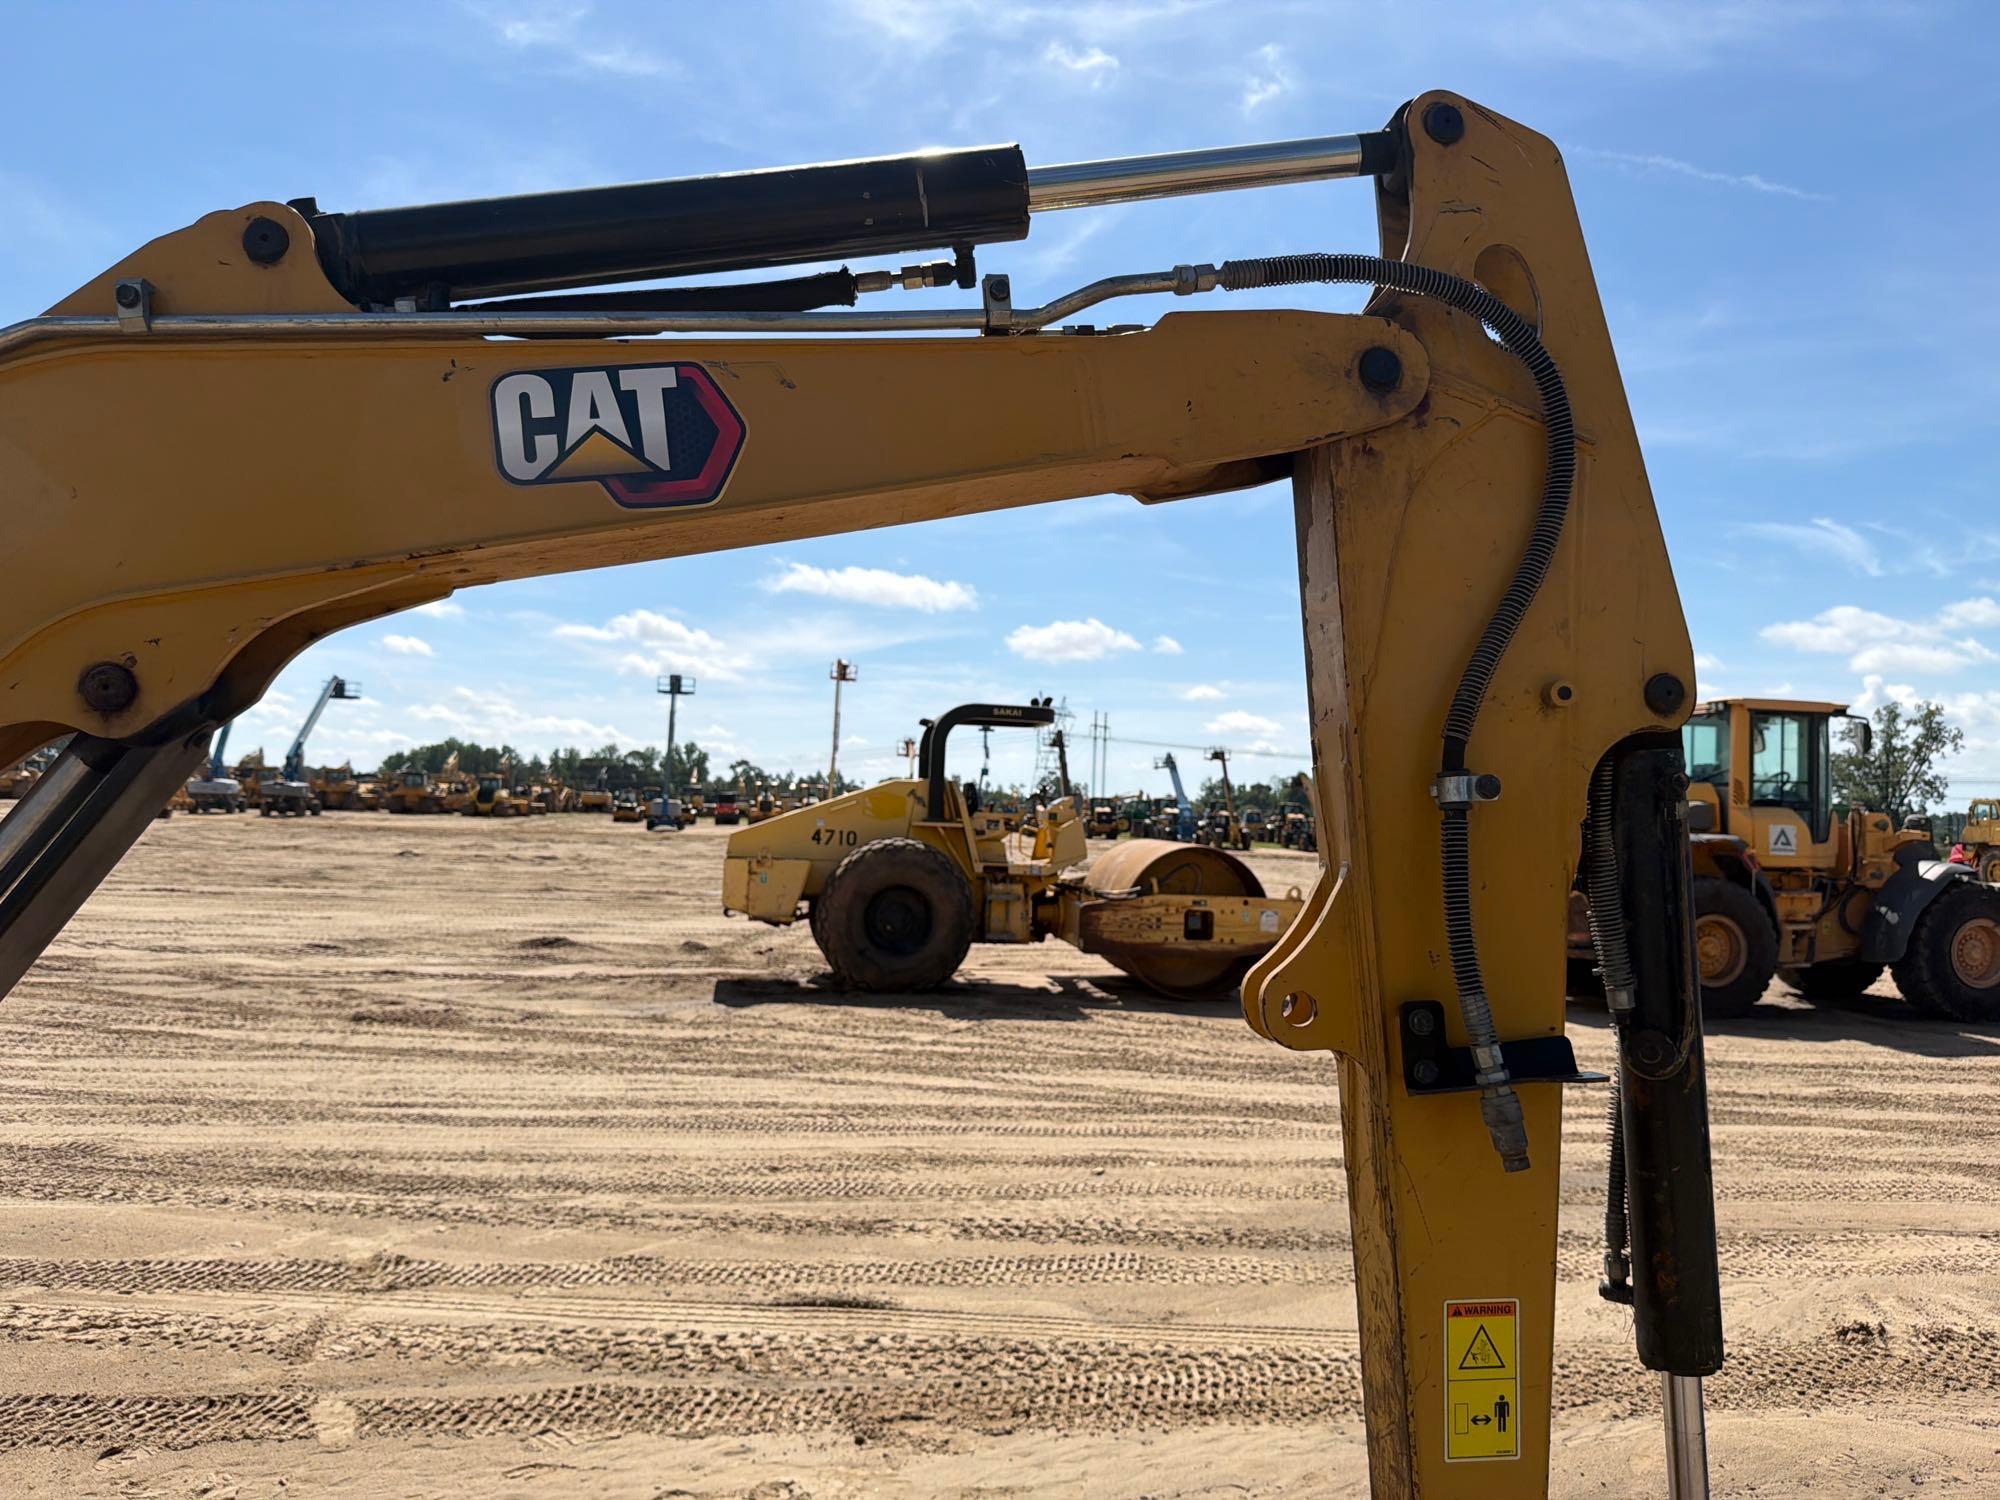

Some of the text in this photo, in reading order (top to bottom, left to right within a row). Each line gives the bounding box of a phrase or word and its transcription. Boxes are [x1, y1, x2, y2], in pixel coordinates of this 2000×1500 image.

[494, 367, 677, 480] CAT
[993, 707, 1022, 717] SAKAI
[811, 829, 857, 846] 4710
[1464, 1305, 1512, 1315] WARNING
